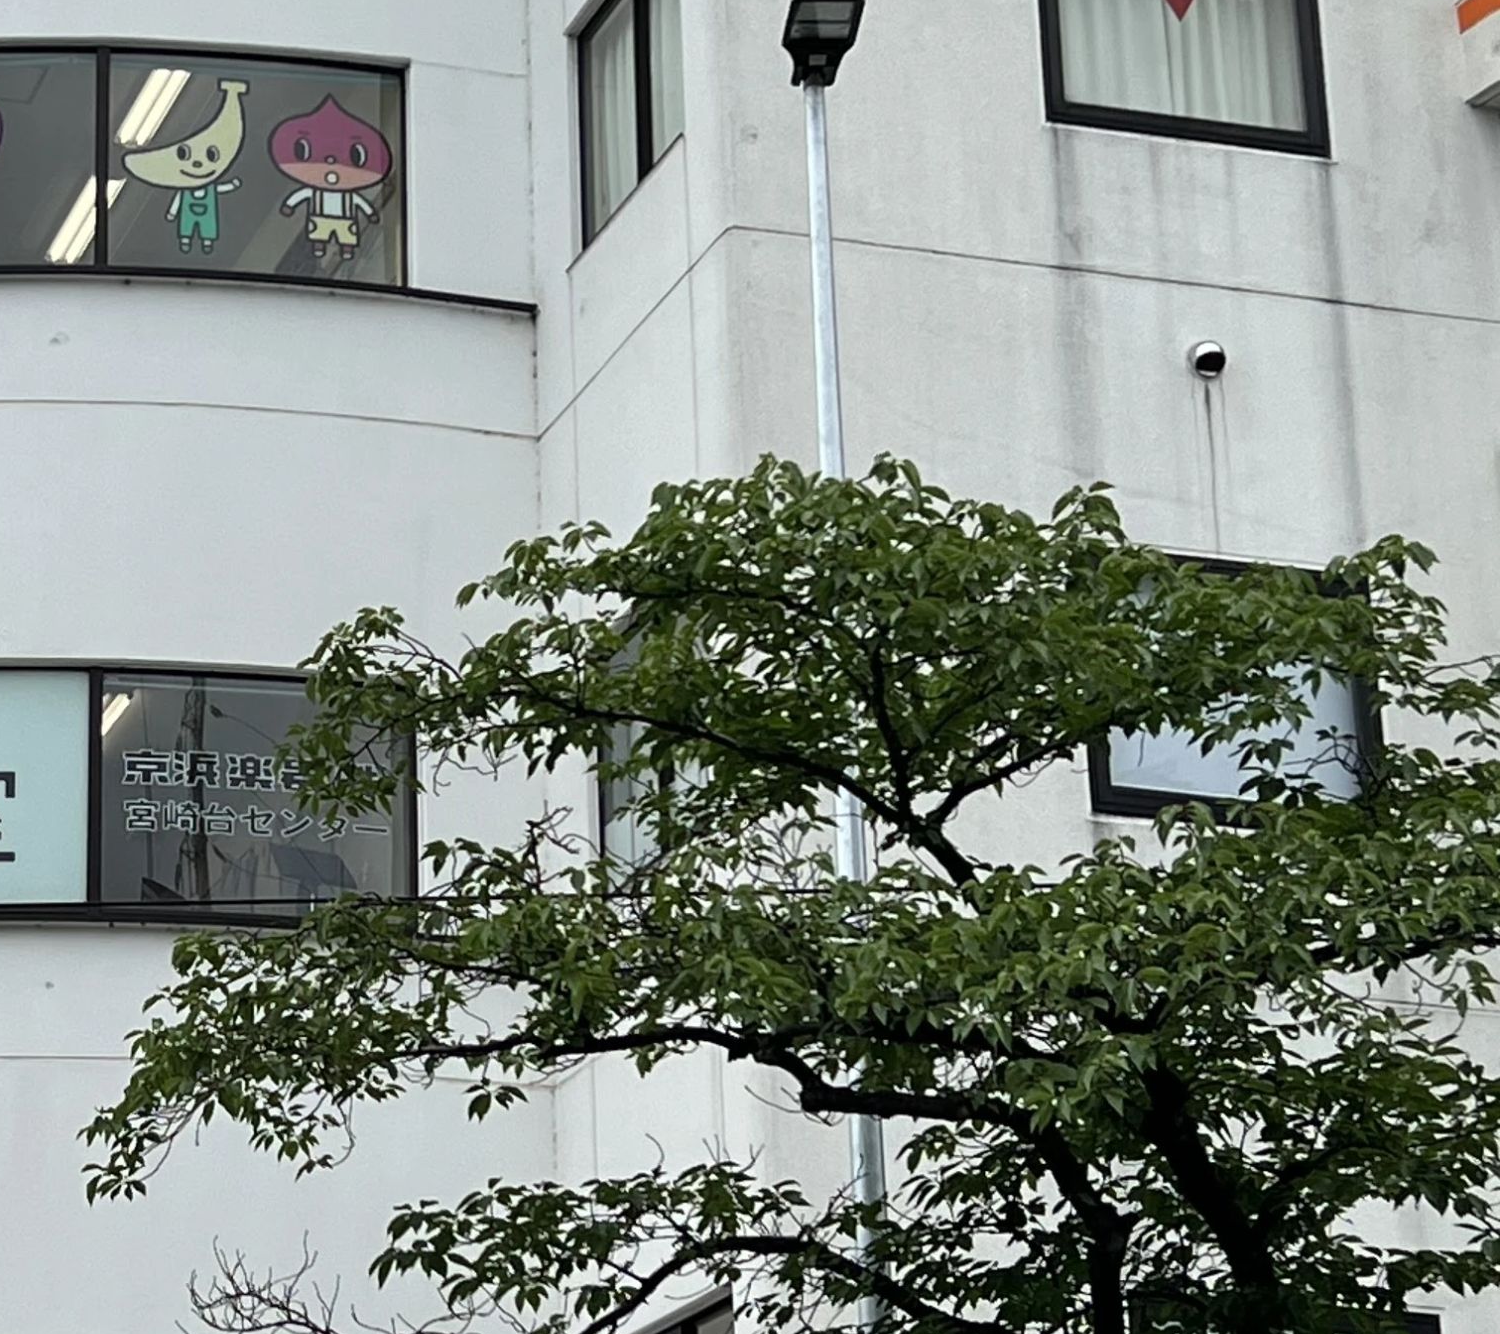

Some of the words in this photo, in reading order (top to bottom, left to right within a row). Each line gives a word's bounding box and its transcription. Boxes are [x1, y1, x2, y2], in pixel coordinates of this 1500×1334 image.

[122, 798, 390, 842] 宮崎台センター
